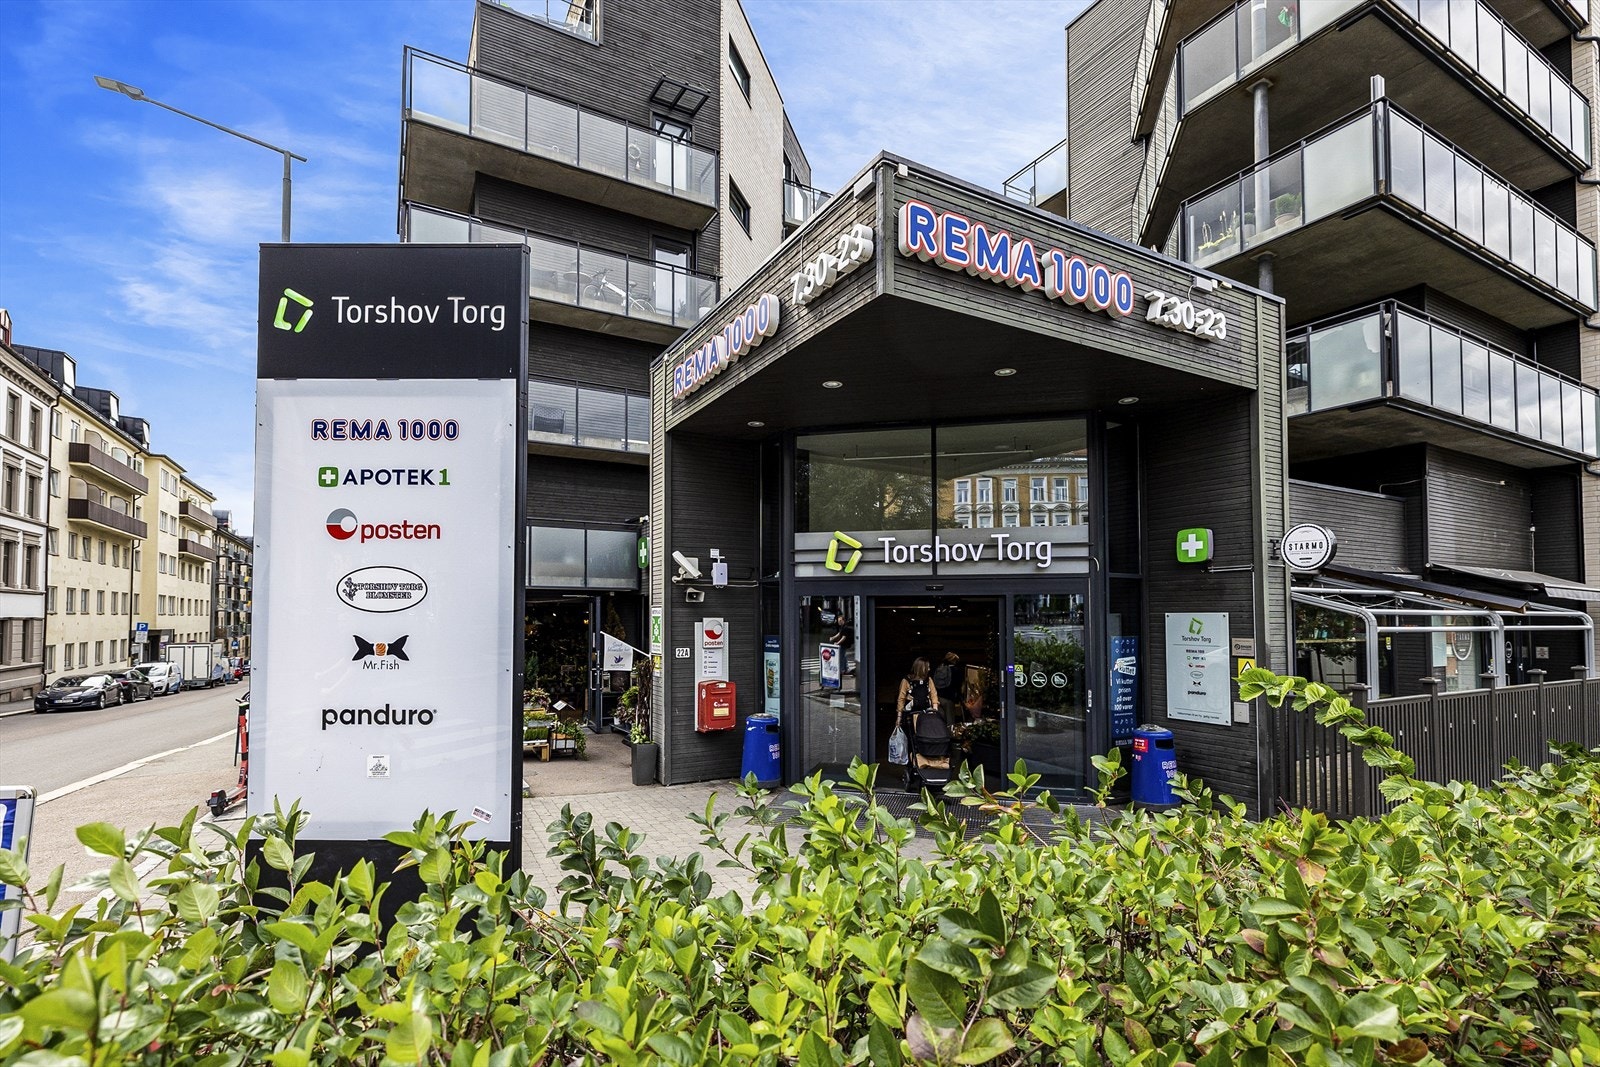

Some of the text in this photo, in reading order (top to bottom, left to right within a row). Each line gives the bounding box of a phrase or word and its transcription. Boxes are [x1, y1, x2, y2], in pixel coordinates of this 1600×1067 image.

[900, 199, 1134, 317] REMA 1000
[332, 296, 506, 331] Torshov Torg
[673, 293, 778, 399] REMA 1000
[311, 418, 460, 441] REMA 1000
[342, 468, 451, 485] APOTEK 1
[360, 520, 441, 543] posten
[877, 533, 1052, 568] Torshov Torg
[1289, 541, 1323, 551] STARMO
[358, 582, 423, 591] TORSHOV TORG
[366, 591, 412, 599] BLOMSTER
[676, 648, 689, 657] 22A
[362, 660, 400, 670] Mr.Fish
